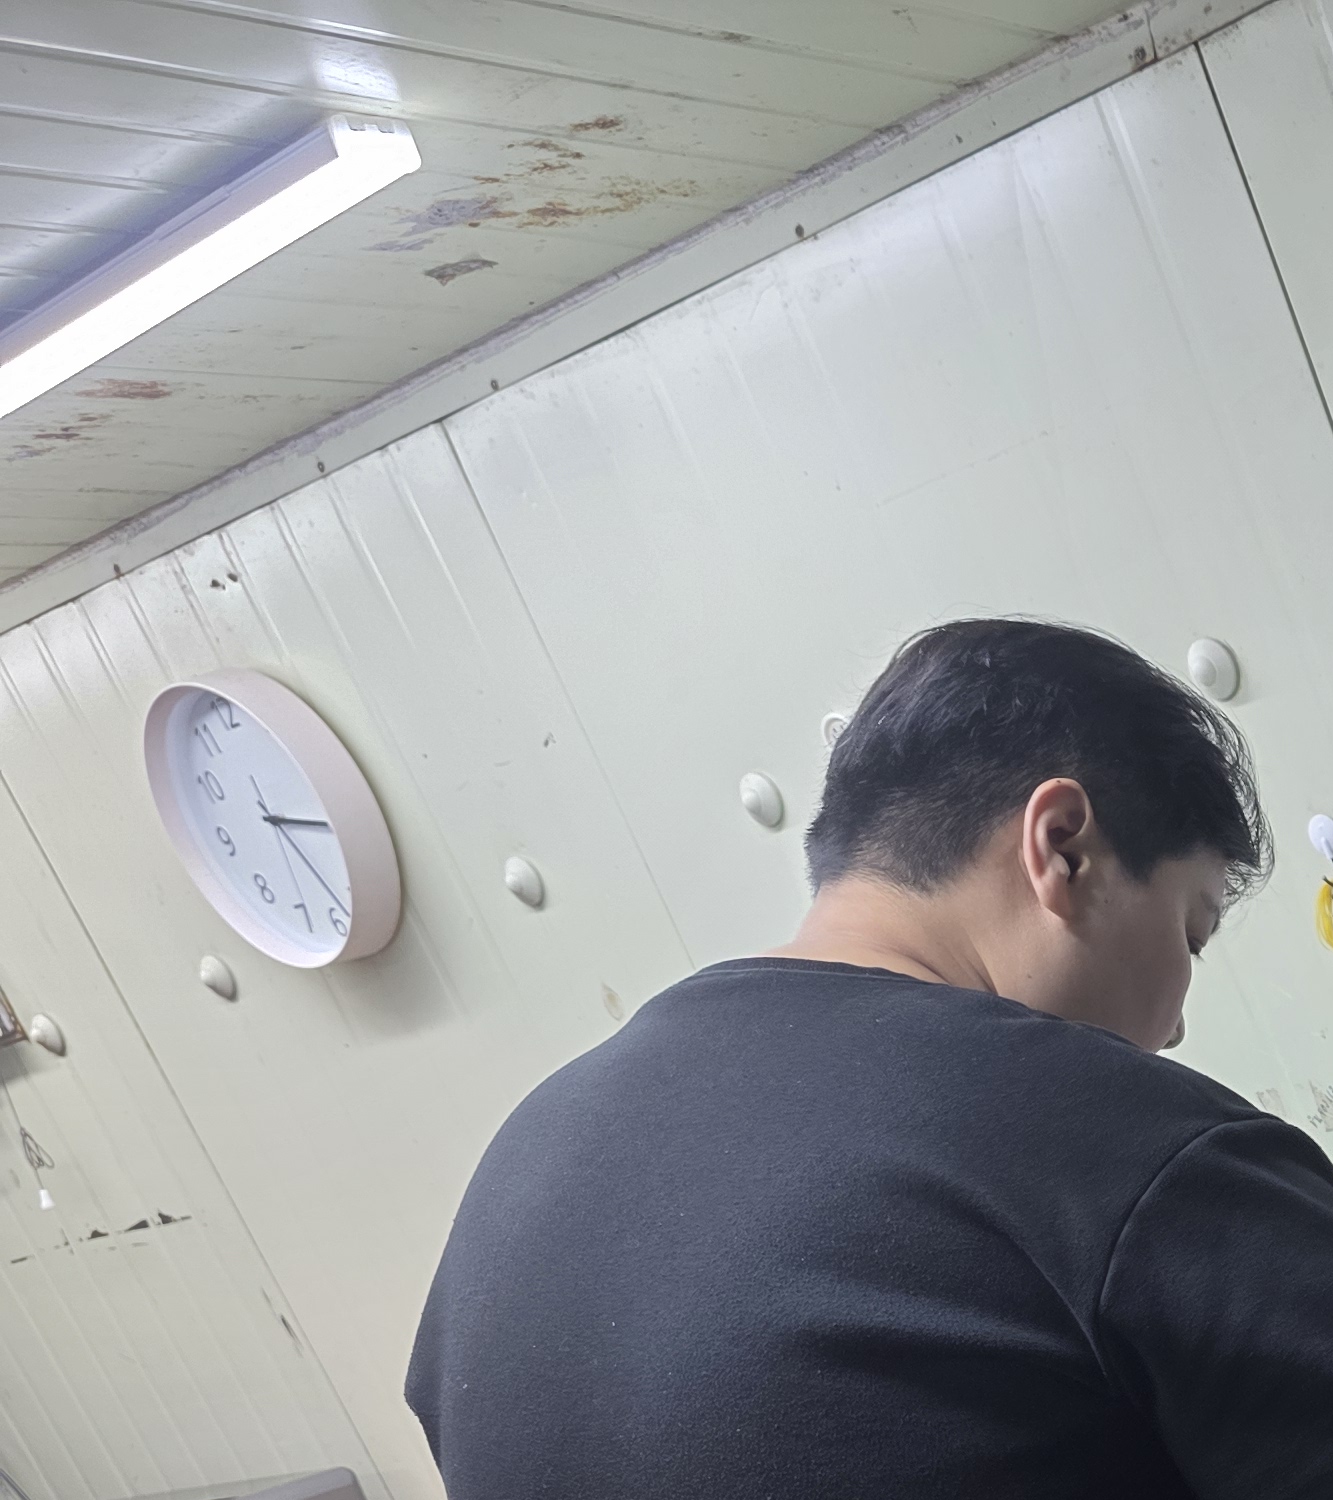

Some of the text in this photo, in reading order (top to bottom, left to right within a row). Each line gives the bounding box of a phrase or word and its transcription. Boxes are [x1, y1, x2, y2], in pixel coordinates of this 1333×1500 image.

[210, 697, 240, 731] 12
[194, 724, 222, 757] 11
[197, 770, 225, 804] 10
[216, 826, 236, 857] 9
[254, 873, 275, 904] 8
[294, 903, 314, 933] 7
[329, 907, 348, 937] 6
